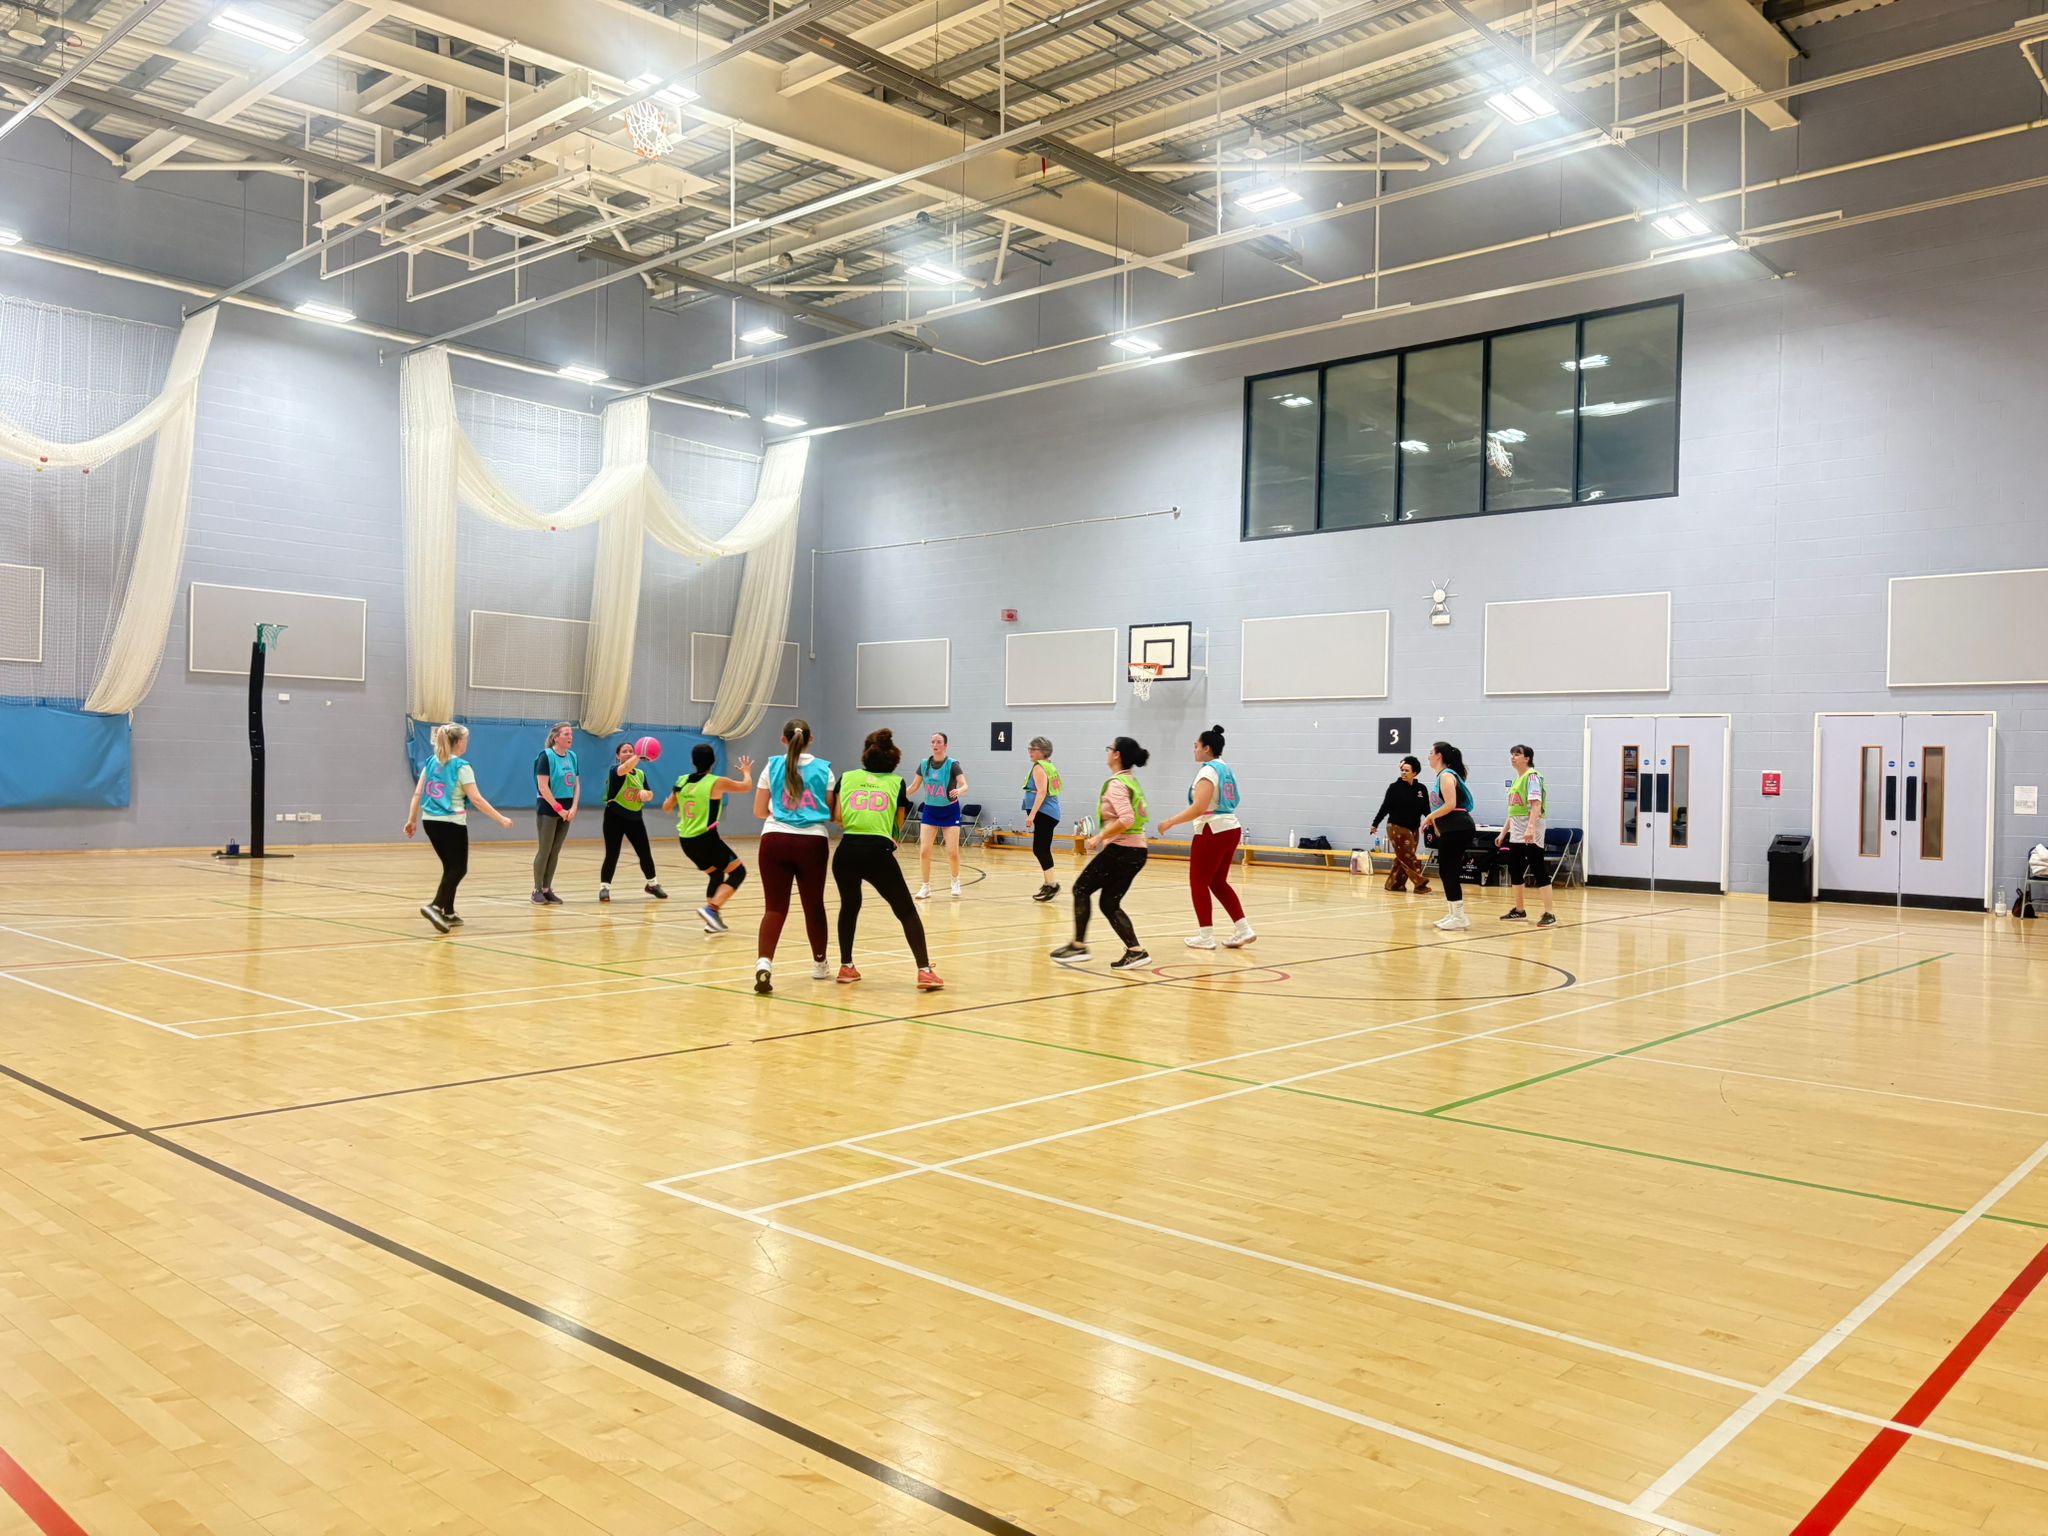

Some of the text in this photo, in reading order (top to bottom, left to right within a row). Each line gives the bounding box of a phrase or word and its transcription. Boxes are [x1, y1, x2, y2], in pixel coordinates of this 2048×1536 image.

[997, 731, 1006, 743] 4
[1389, 728, 1399, 745] 3
[850, 790, 889, 812] GD
[684, 801, 697, 819] C
